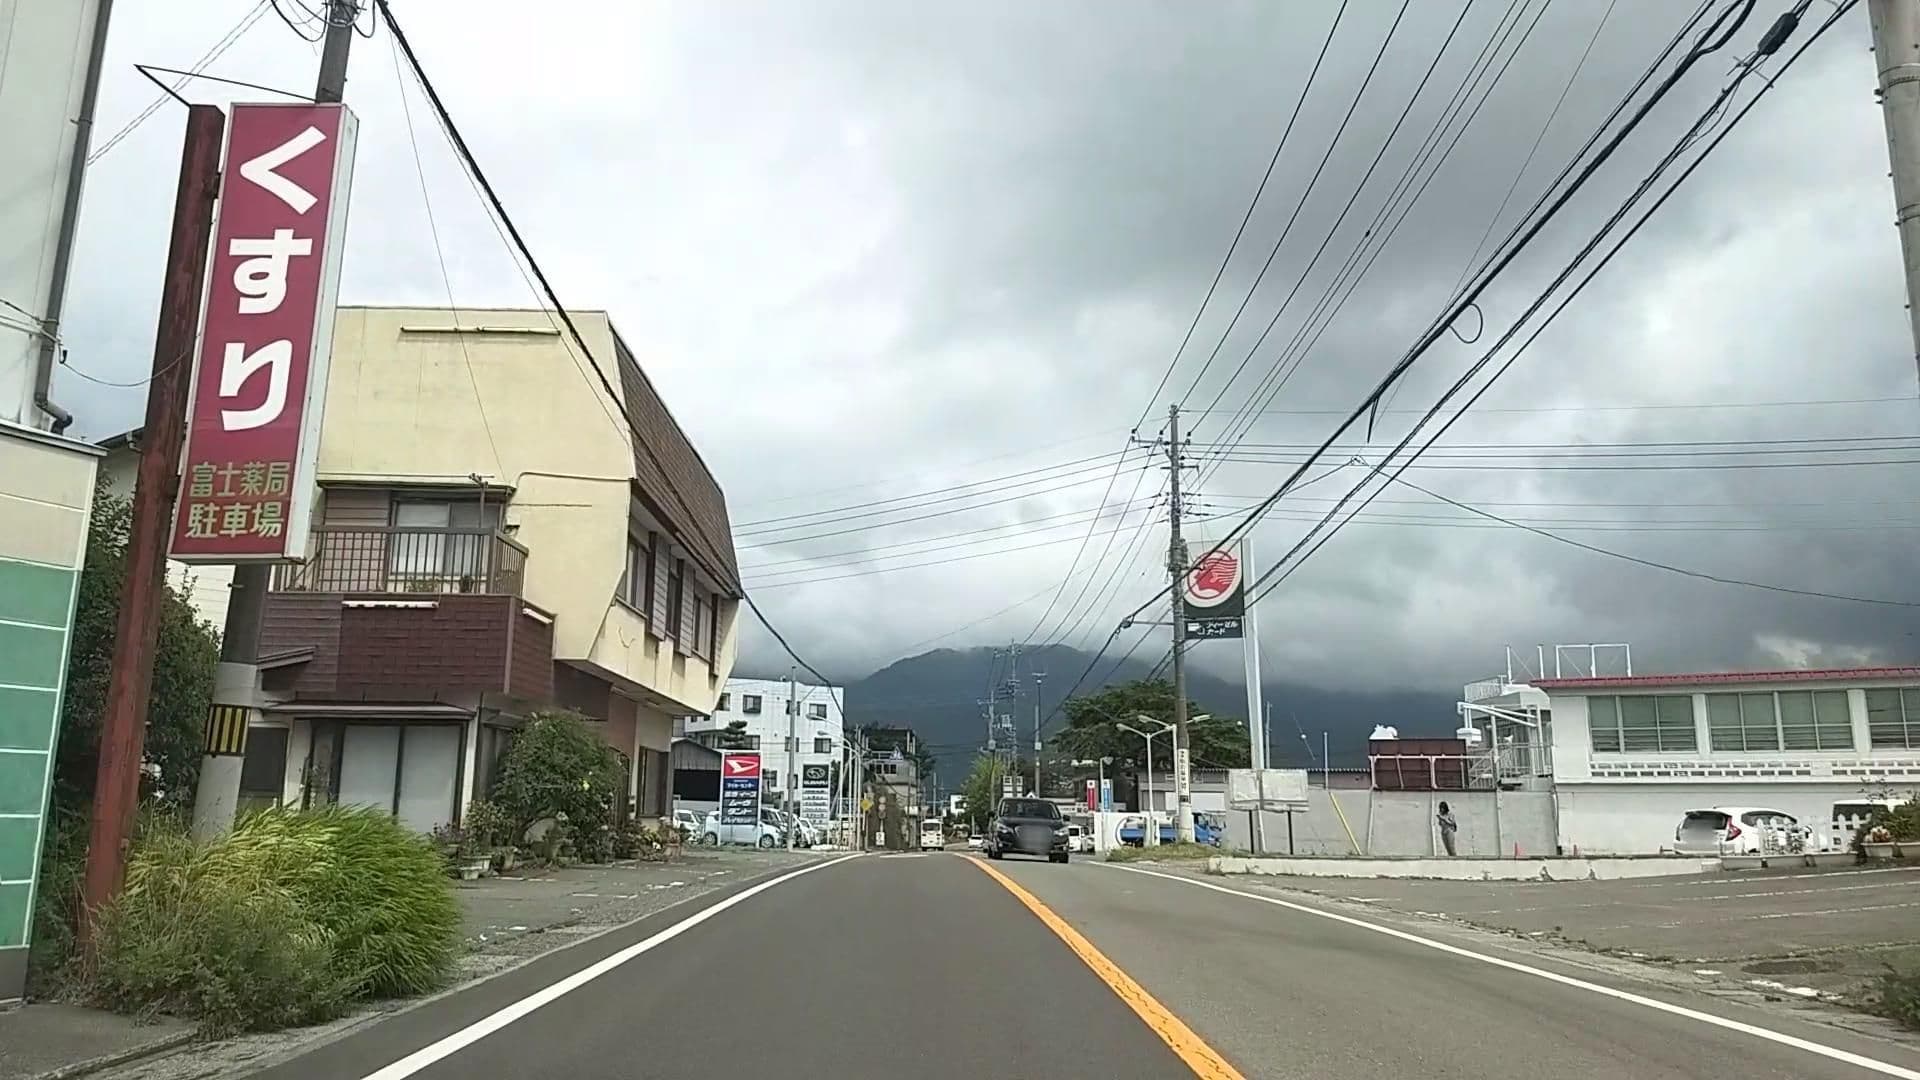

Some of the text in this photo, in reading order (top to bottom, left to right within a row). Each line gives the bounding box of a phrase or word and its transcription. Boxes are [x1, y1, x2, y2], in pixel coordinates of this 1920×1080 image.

[219, 124, 327, 432] くすり
[189, 461, 291, 498] 富士薬局
[184, 502, 285, 538] 駐車場
